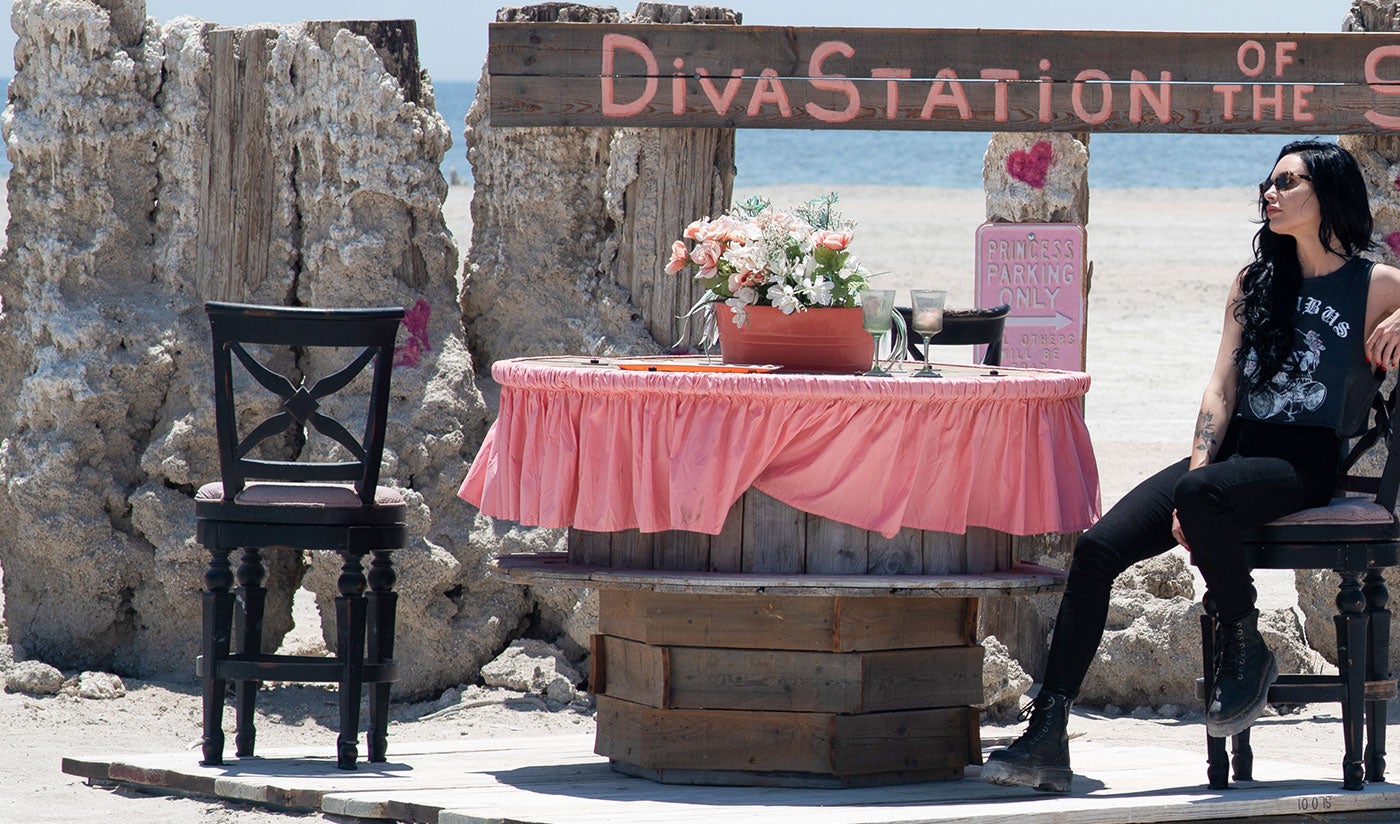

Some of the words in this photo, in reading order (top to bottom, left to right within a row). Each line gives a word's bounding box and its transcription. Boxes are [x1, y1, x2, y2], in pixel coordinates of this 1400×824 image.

[1237, 39, 1298, 78] OF
[1213, 84, 1315, 122] THE
[988, 240, 1074, 260] PRINCESS
[987, 263, 1075, 284] PARKING
[1000, 287, 1061, 308] ONLY
[1296, 296, 1351, 338] BUS
[1021, 333, 1075, 345] OTHERS
[1043, 348, 1060, 359] BE
